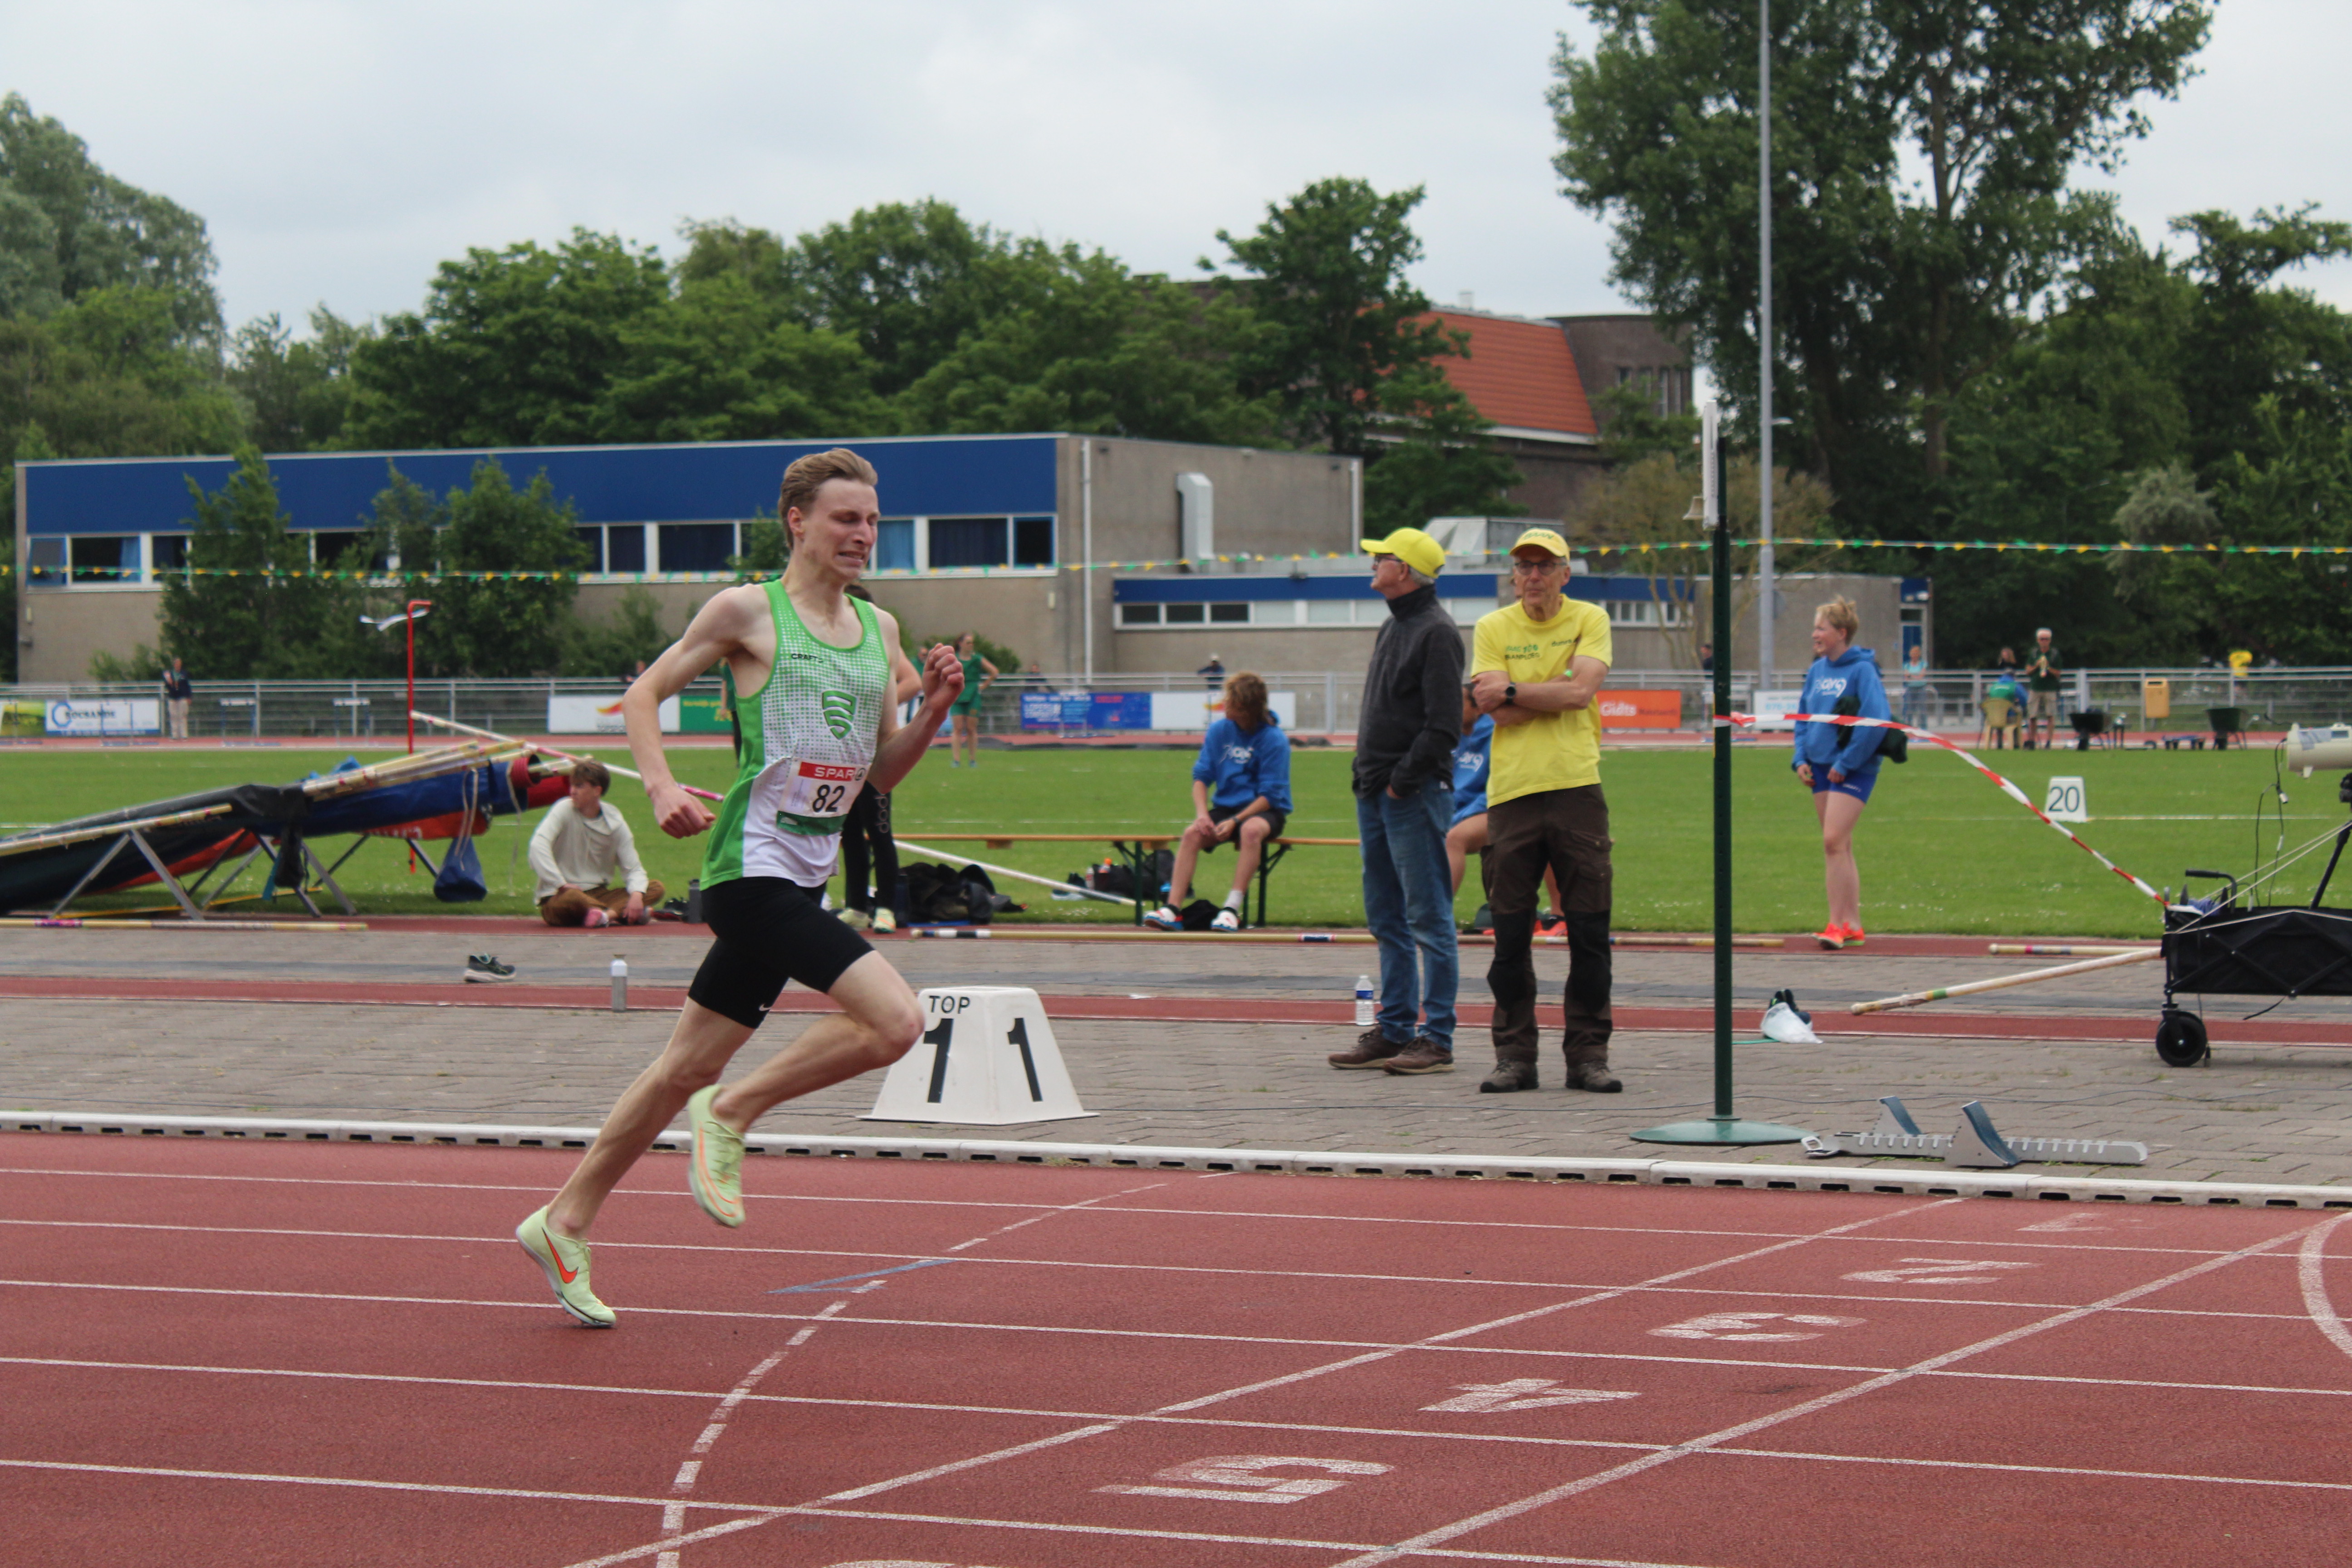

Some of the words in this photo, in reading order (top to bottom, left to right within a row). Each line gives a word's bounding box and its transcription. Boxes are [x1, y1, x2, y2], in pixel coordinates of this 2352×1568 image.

[814, 767, 855, 779] SPAR
[813, 784, 845, 813] 82
[2049, 786, 2080, 813] 20
[928, 995, 970, 1014] TOP
[923, 1018, 954, 1104] 1
[1007, 1017, 1044, 1102] 1
[1839, 1257, 2044, 1285] 2
[1646, 1311, 1867, 1343] 3
[1416, 1378, 1642, 1413] 4
[1091, 1455, 1395, 1504] 5
